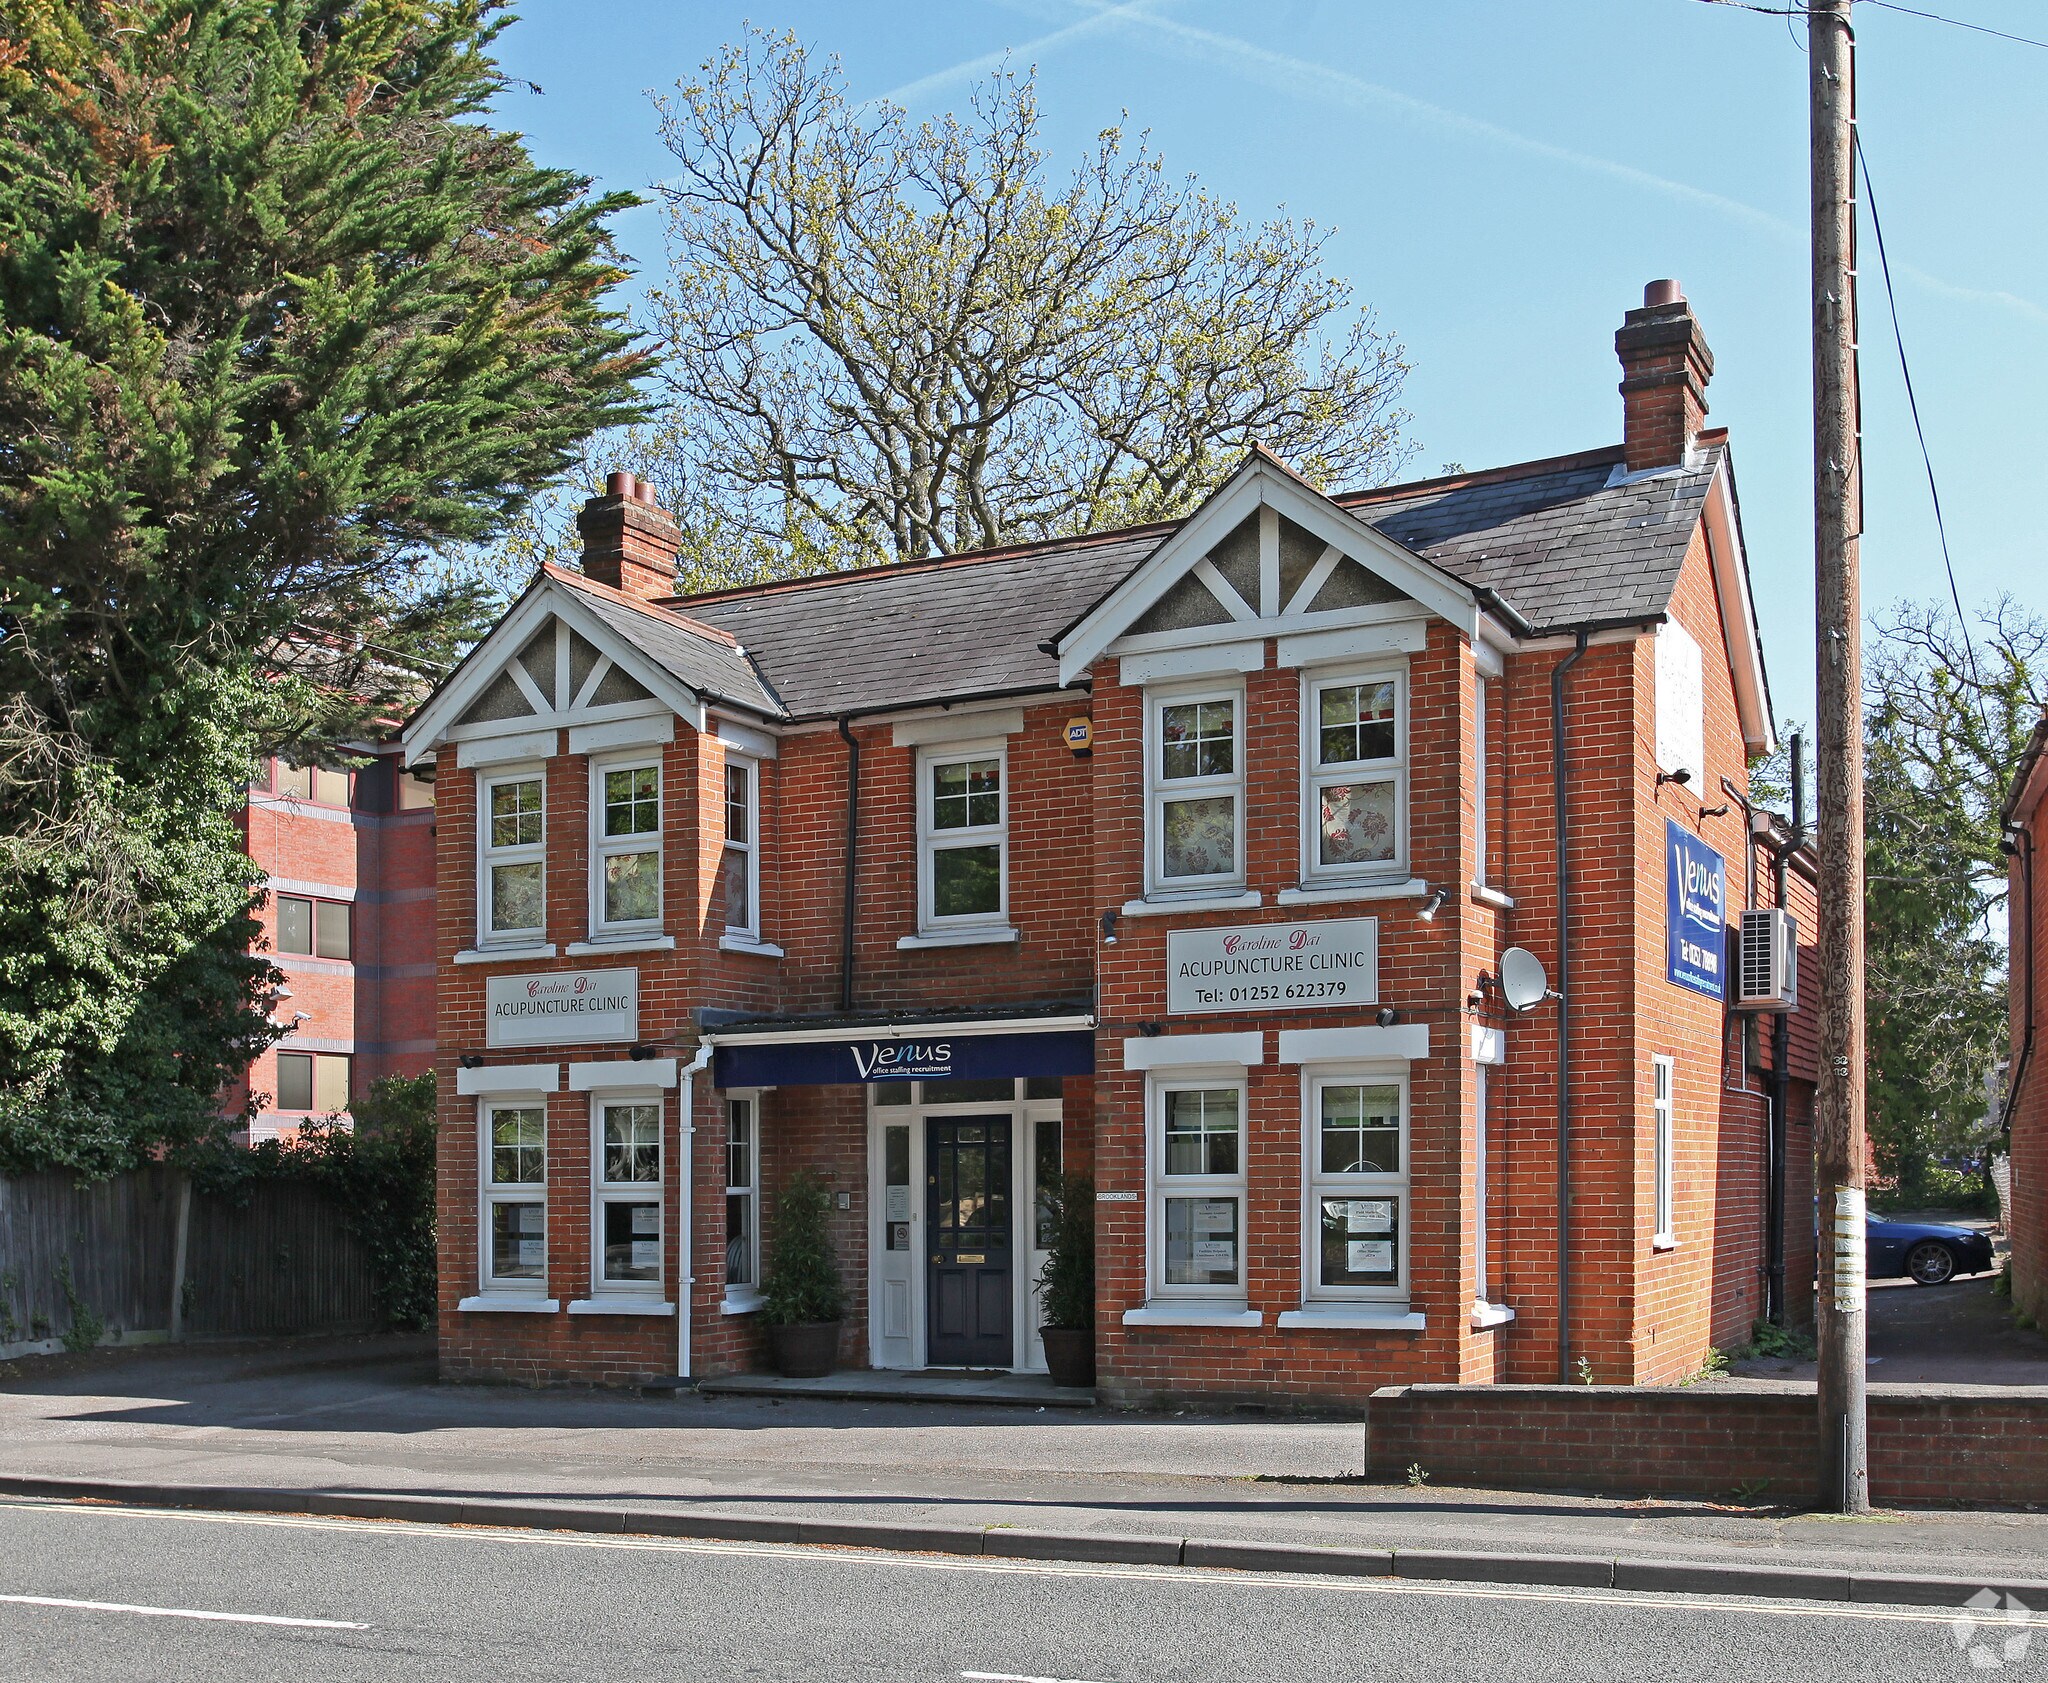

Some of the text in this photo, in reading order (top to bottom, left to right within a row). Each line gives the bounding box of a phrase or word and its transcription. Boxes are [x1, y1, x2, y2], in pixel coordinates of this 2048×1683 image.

[1070, 729, 1085, 738] ADT
[1674, 844, 1720, 916] Venus
[1223, 929, 1322, 955] Caroline Dai
[1179, 951, 1365, 978] ACUPUNCTURE CLINIC
[526, 976, 597, 998] Caroline Dai
[1195, 981, 1347, 1003] Tel: 01252 622379
[495, 995, 628, 1017] ACUPUNCTURE CLINIC
[850, 1043, 952, 1079] Venus
[890, 1066, 911, 1075] staffing
[911, 1065, 952, 1073] recruitment
